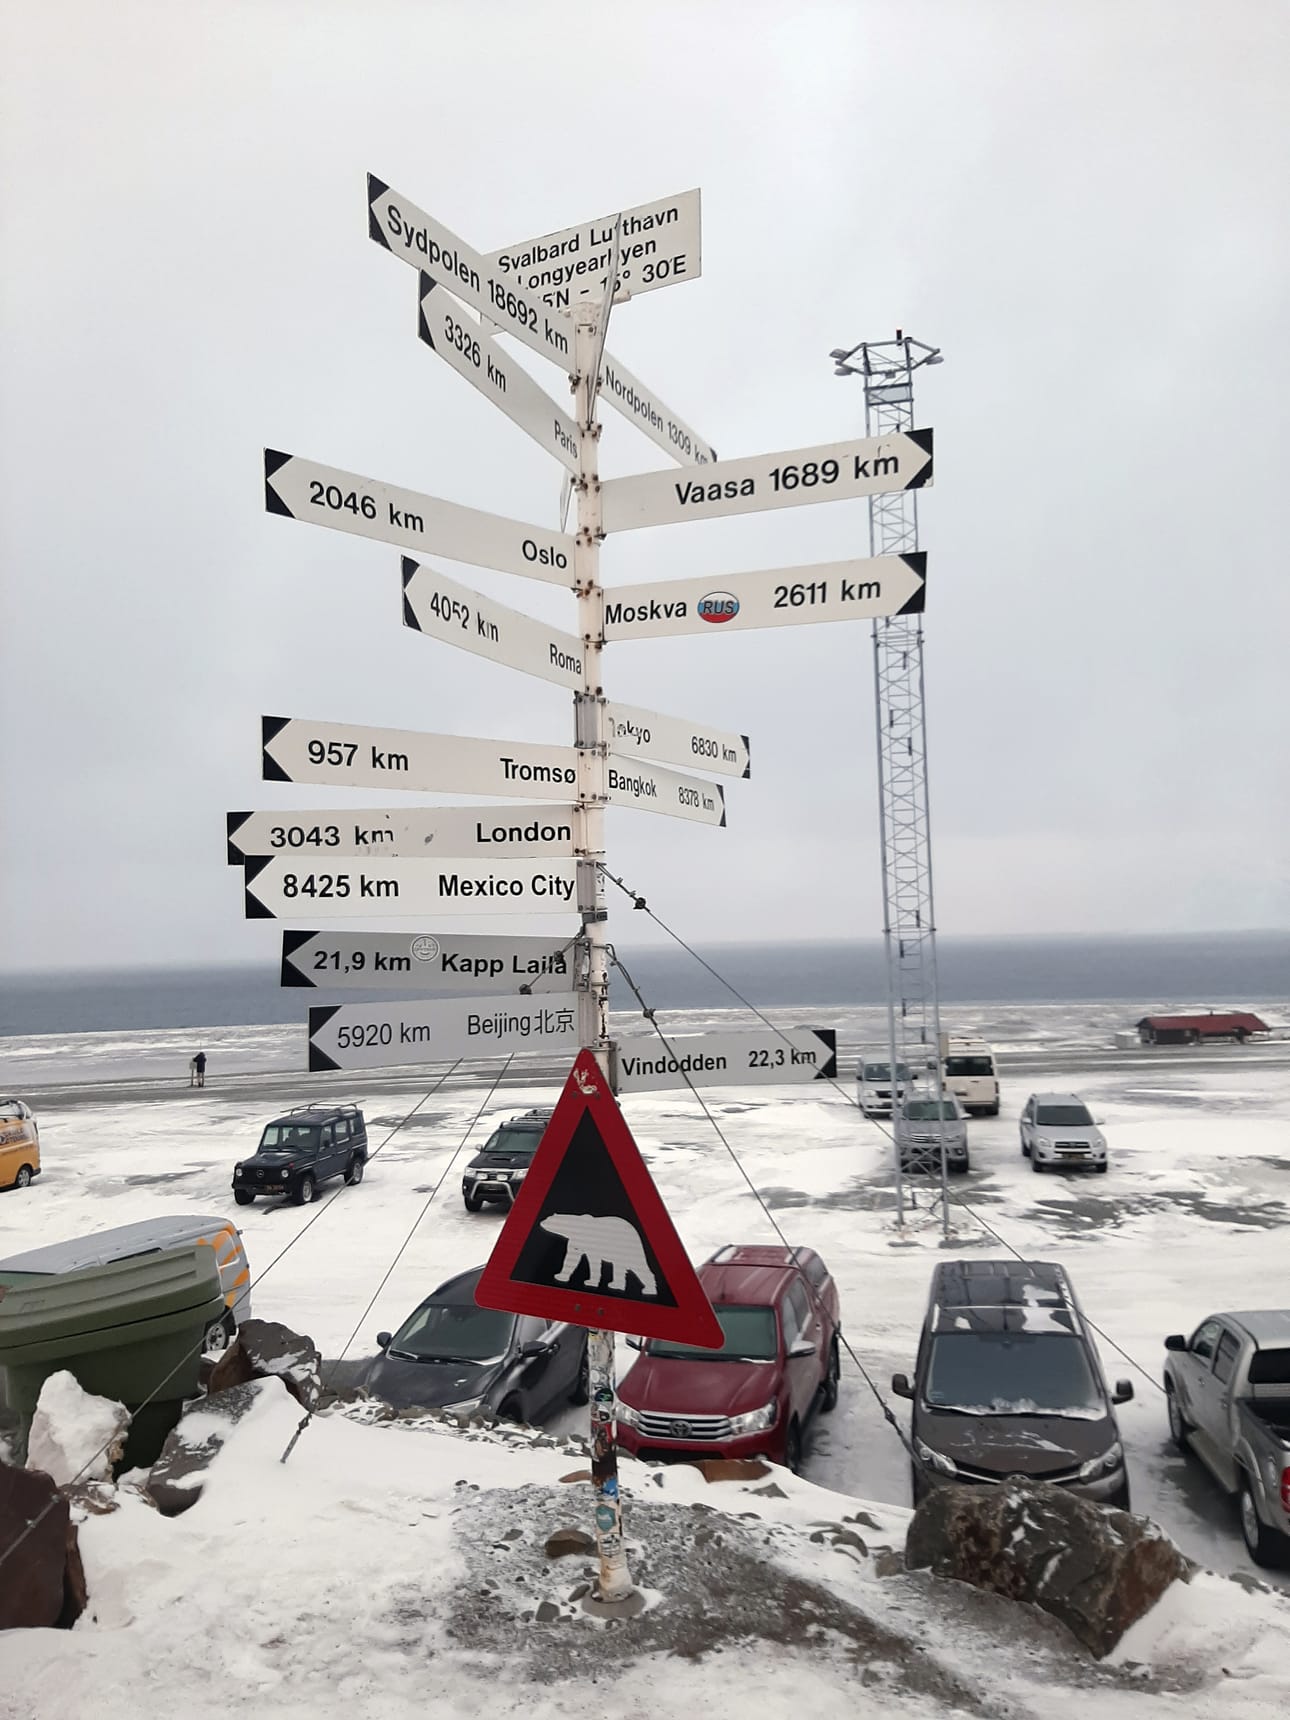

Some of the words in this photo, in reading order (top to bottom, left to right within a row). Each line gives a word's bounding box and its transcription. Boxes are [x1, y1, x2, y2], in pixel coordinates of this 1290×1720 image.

[498, 233, 580, 273] Svalbard
[590, 208, 678, 247] Luthavn
[387, 204, 480, 292] Sydpolen
[487, 279, 538, 334] 18692
[545, 318, 569, 354] km
[444, 315, 481, 368] 3326
[487, 354, 507, 393] km
[554, 419, 578, 459] Paris
[605, 365, 664, 432] Nordpolen
[667, 420, 692, 455] 1309
[675, 477, 755, 505] Vaasa
[768, 459, 839, 492] 1689
[853, 454, 899, 479] km
[309, 480, 377, 520] 2046
[389, 503, 424, 533] km
[521, 539, 568, 569] Oslo
[605, 600, 688, 625] Moskva
[702, 600, 735, 615] RUS
[773, 582, 827, 609] 2611
[841, 579, 881, 602] km
[430, 592, 469, 630] 4052
[477, 611, 499, 642] km
[549, 643, 582, 675] Roma
[307, 740, 358, 767] 957
[371, 746, 409, 771] km
[500, 758, 576, 784] Tromsø
[691, 735, 719, 758] 6830
[722, 743, 737, 763] km
[608, 769, 658, 798] Bangkok
[678, 786, 700, 808] 8378
[702, 793, 715, 811] km
[270, 826, 340, 848] 3043
[355, 825, 394, 846] km
[476, 822, 572, 843] London
[282, 874, 351, 898] 8425
[360, 874, 400, 898] km
[438, 874, 524, 898] Mexico
[531, 874, 576, 902] City
[313, 950, 366, 974] 21,9
[374, 951, 411, 972] km
[441, 953, 504, 978] Kapp
[512, 955, 567, 975] Laila
[337, 1023, 392, 1049] 5920
[400, 1022, 431, 1045] km
[621, 1053, 727, 1076] Vindodden
[748, 1049, 785, 1070] 22,3
[791, 1048, 816, 1065] km
